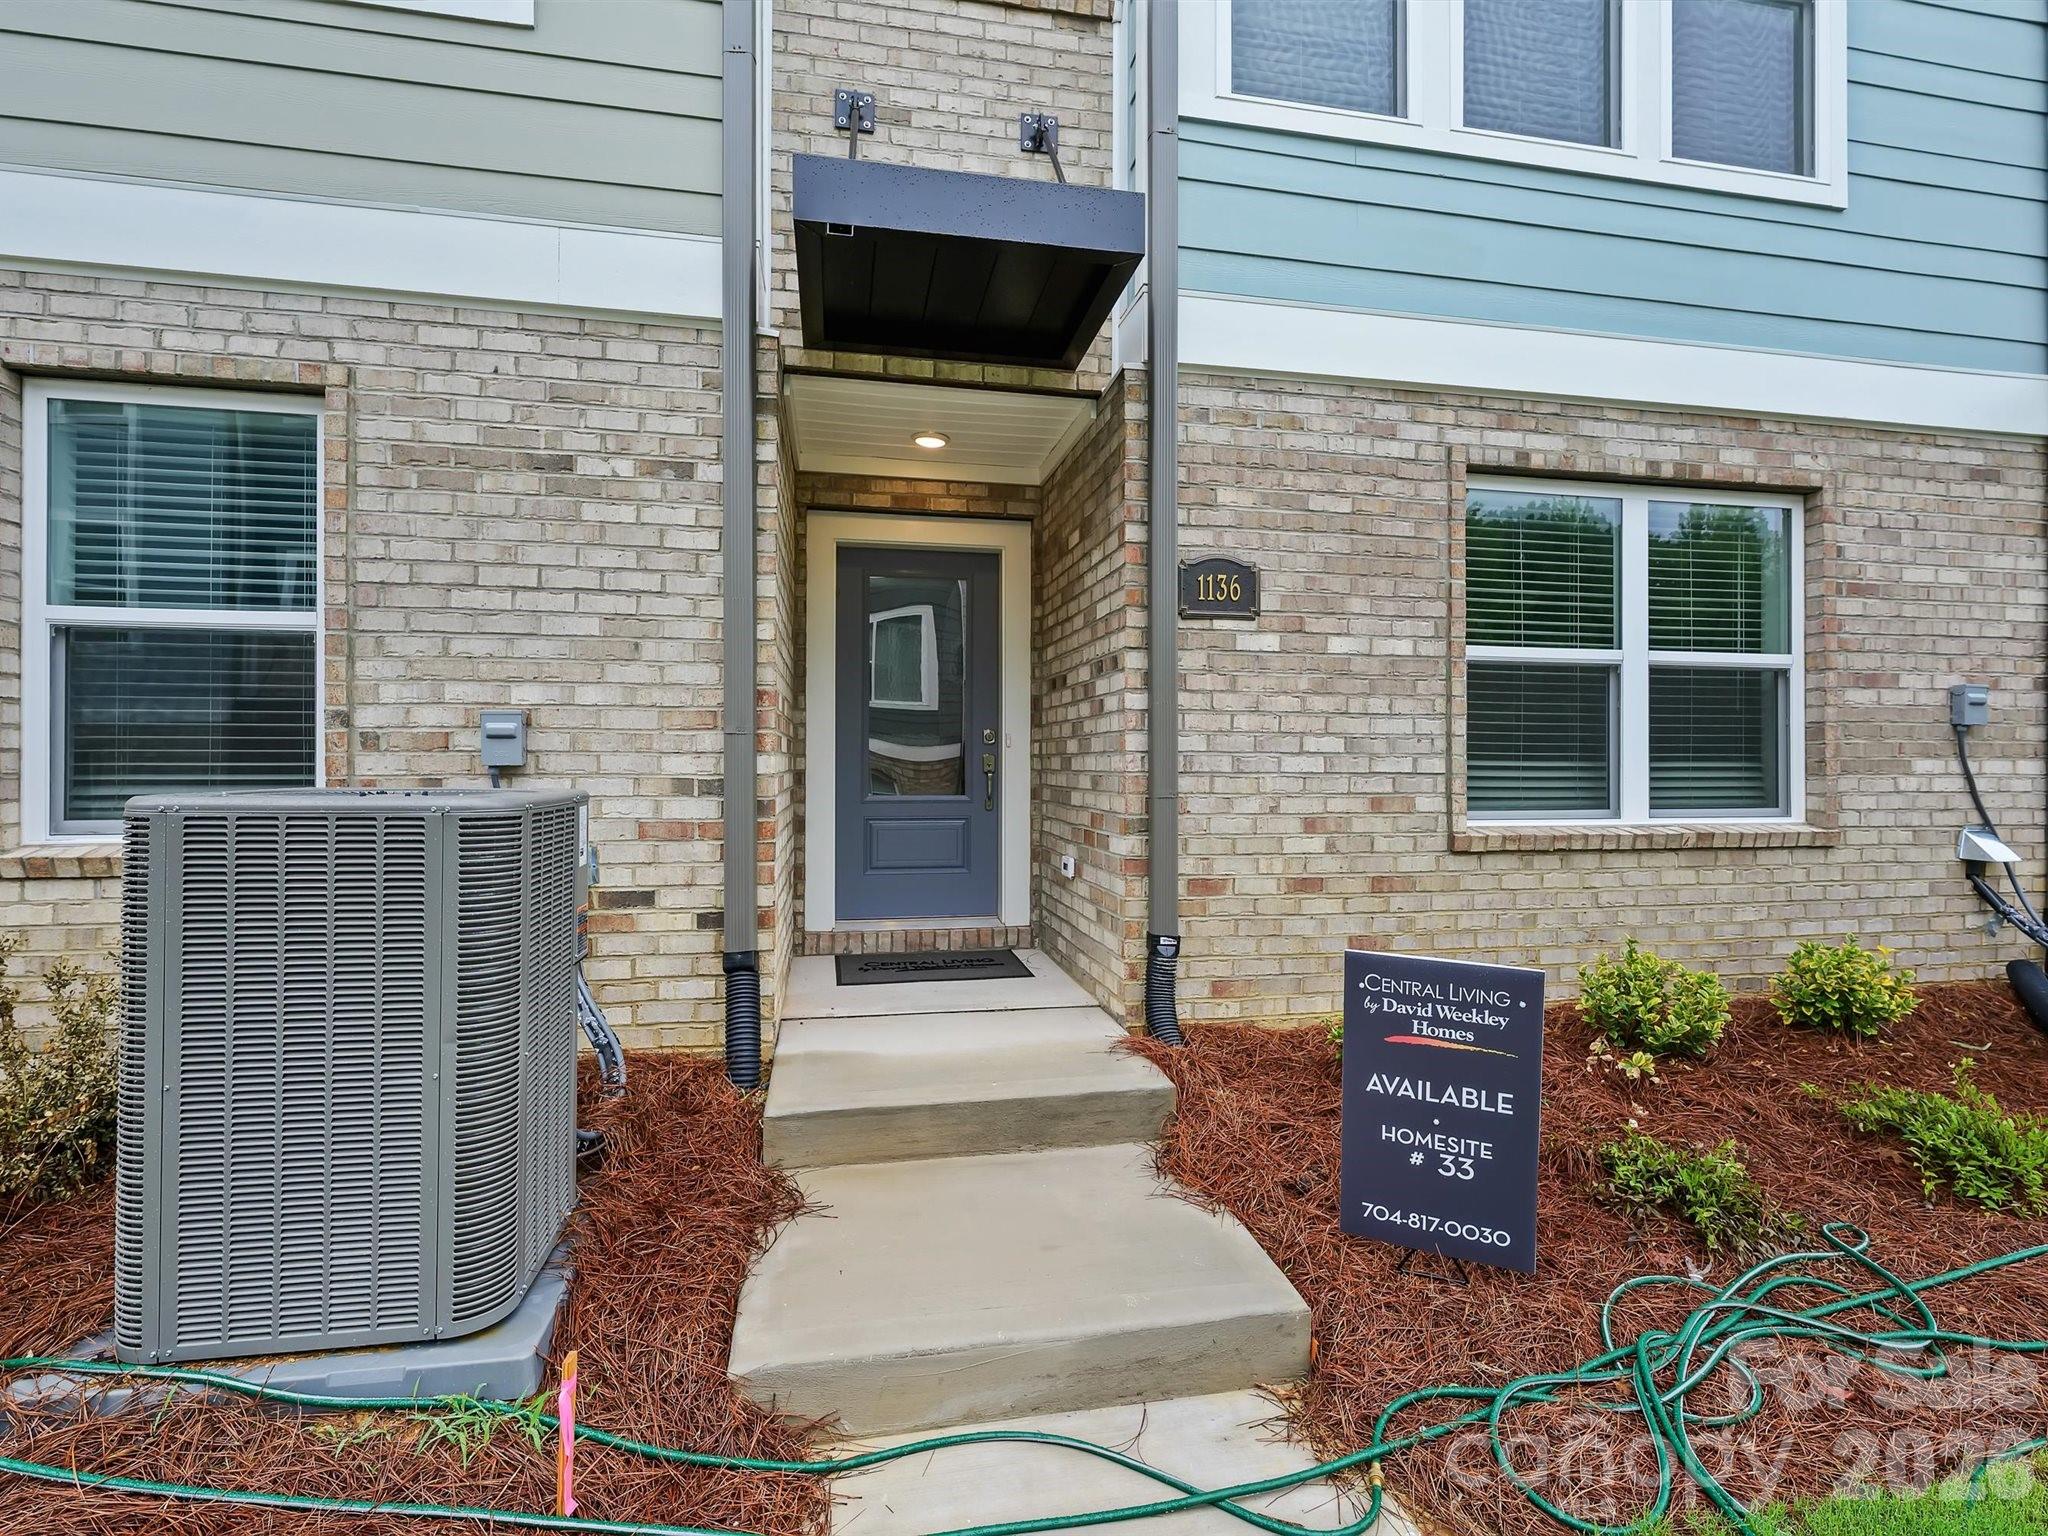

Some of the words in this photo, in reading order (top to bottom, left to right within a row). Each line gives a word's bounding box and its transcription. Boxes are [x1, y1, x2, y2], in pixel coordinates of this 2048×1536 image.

[1197, 573, 1241, 601] 1136
[1364, 973, 1444, 1000] CENTRAL
[1449, 983, 1511, 1007] LIVING
[1363, 995, 1381, 1014] by
[1382, 997, 1433, 1018] David
[1435, 1004, 1510, 1030] Weekley
[1411, 1019, 1475, 1042] Homes
[1365, 1072, 1514, 1115] AVAILABLE
[1381, 1124, 1493, 1160] HOMESITE
[1409, 1151, 1425, 1166] #
[1437, 1153, 1475, 1180] 33
[1361, 1201, 1512, 1247] 704-817-0030
